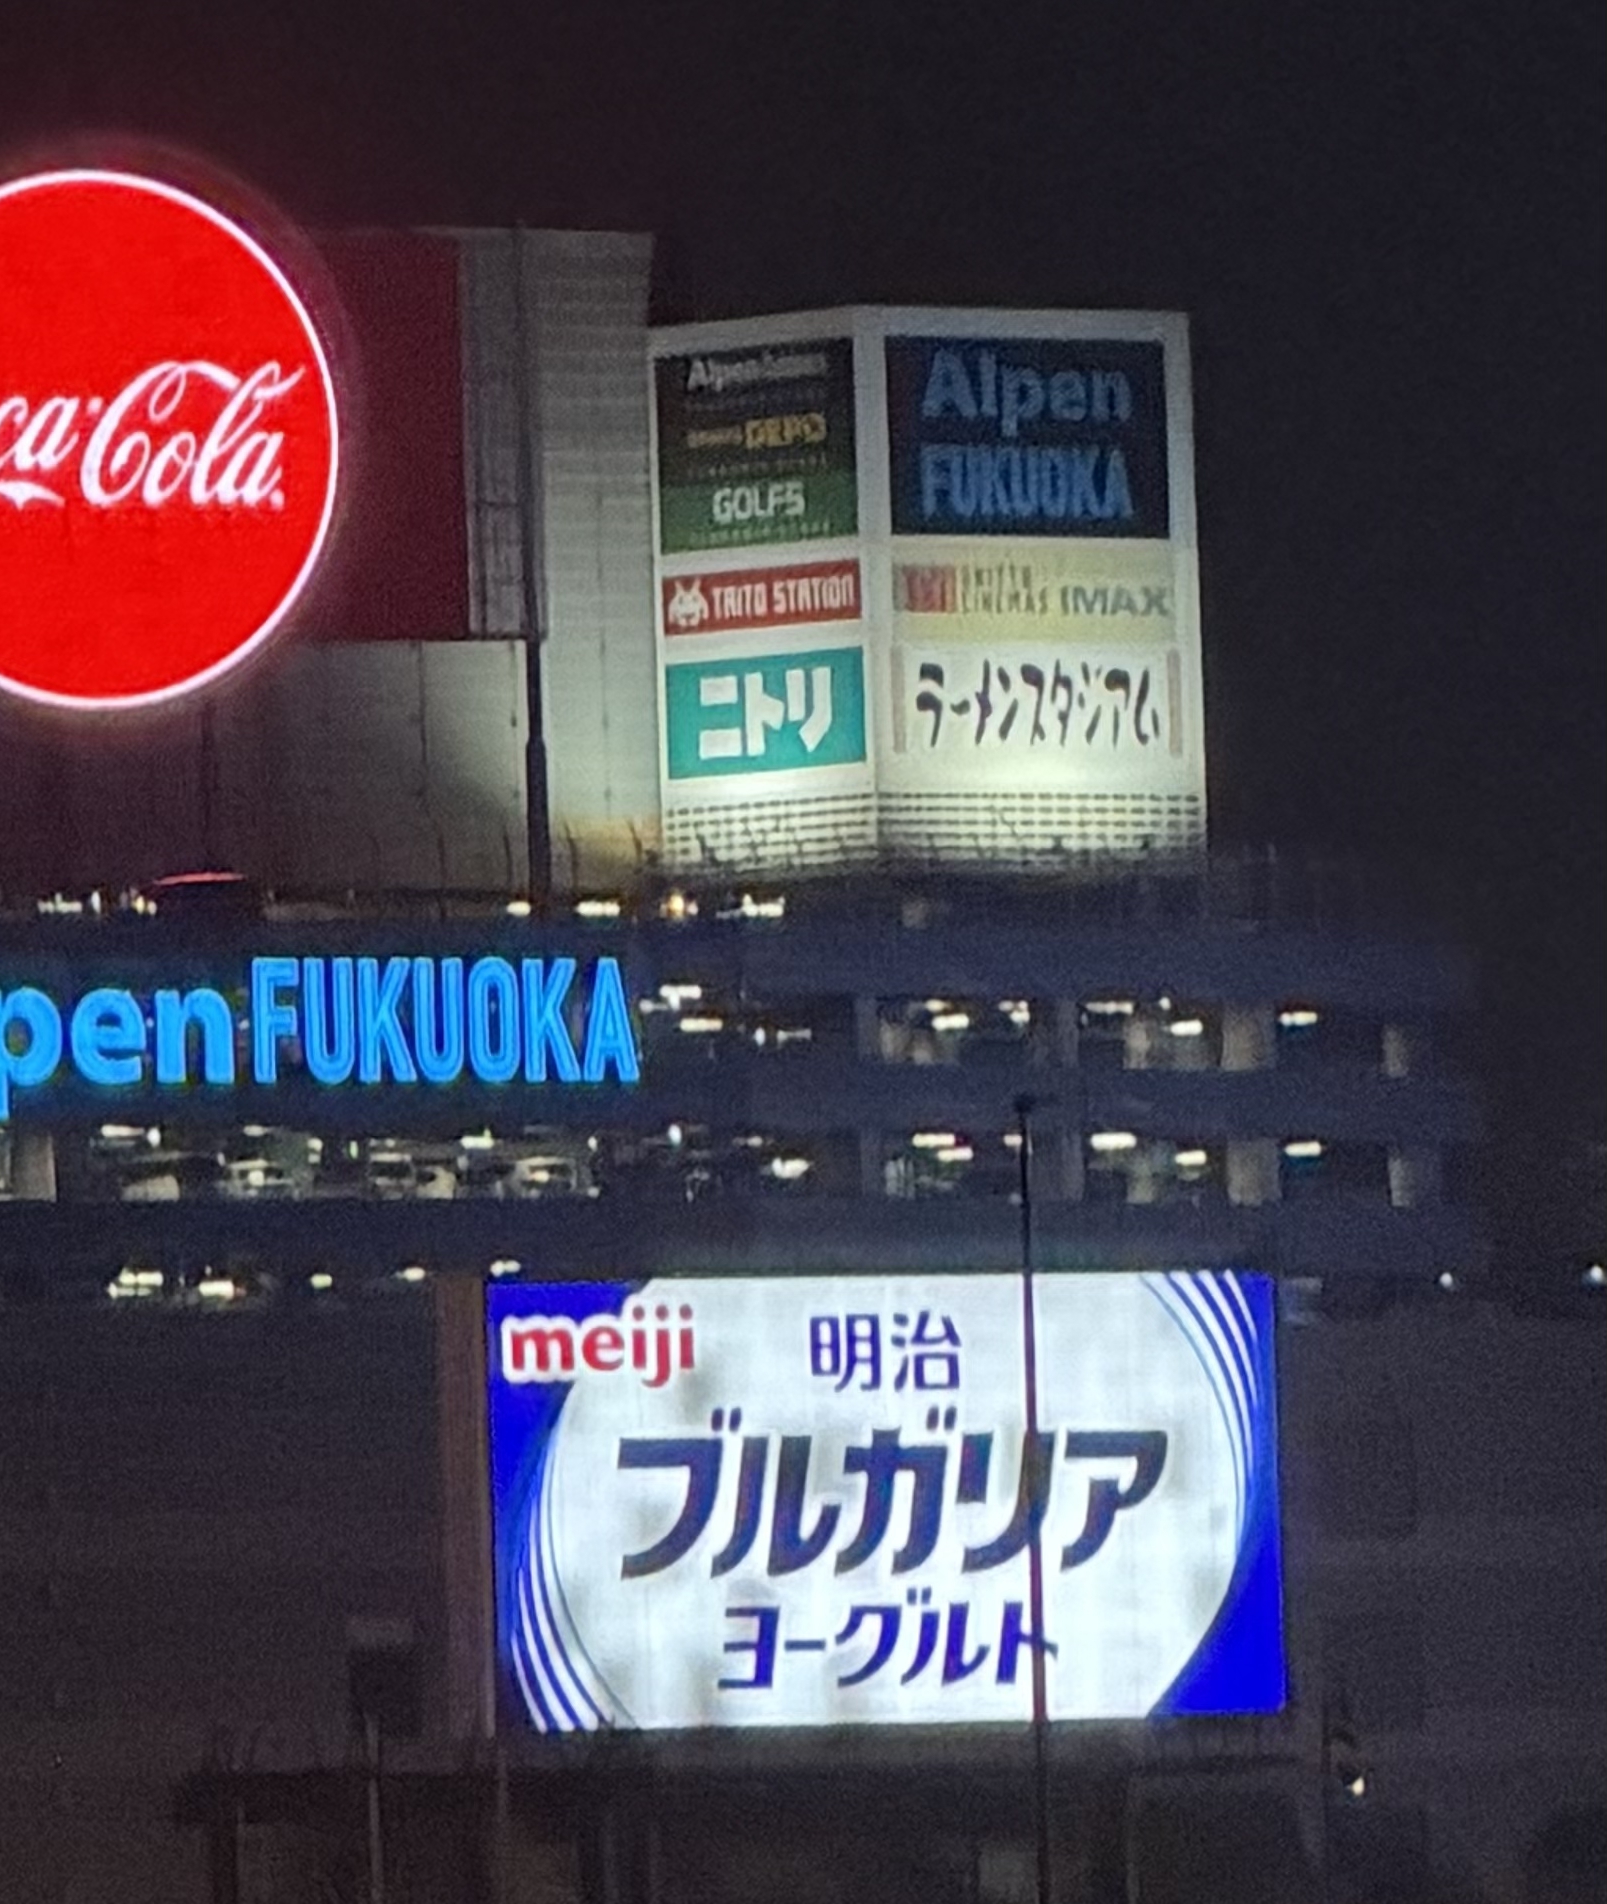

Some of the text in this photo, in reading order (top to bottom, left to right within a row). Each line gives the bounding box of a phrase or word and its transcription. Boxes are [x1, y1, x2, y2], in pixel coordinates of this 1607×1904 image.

[922, 348, 1133, 438] Alpen
[920, 444, 1135, 520] FUKUOKA
[712, 573, 855, 620] TAITO STATION
[1060, 584, 1170, 617] IMAX
[699, 665, 833, 761] ニトリ
[915, 657, 1160, 749] ラーメンスタジアム
[250, 955, 642, 1085] FUKUOKA
[508, 1303, 697, 1388] meiji
[809, 1309, 963, 1393] 明治
[616, 1406, 1169, 1580] ブルガリア
[716, 1586, 1060, 1691] ヨーグルト
